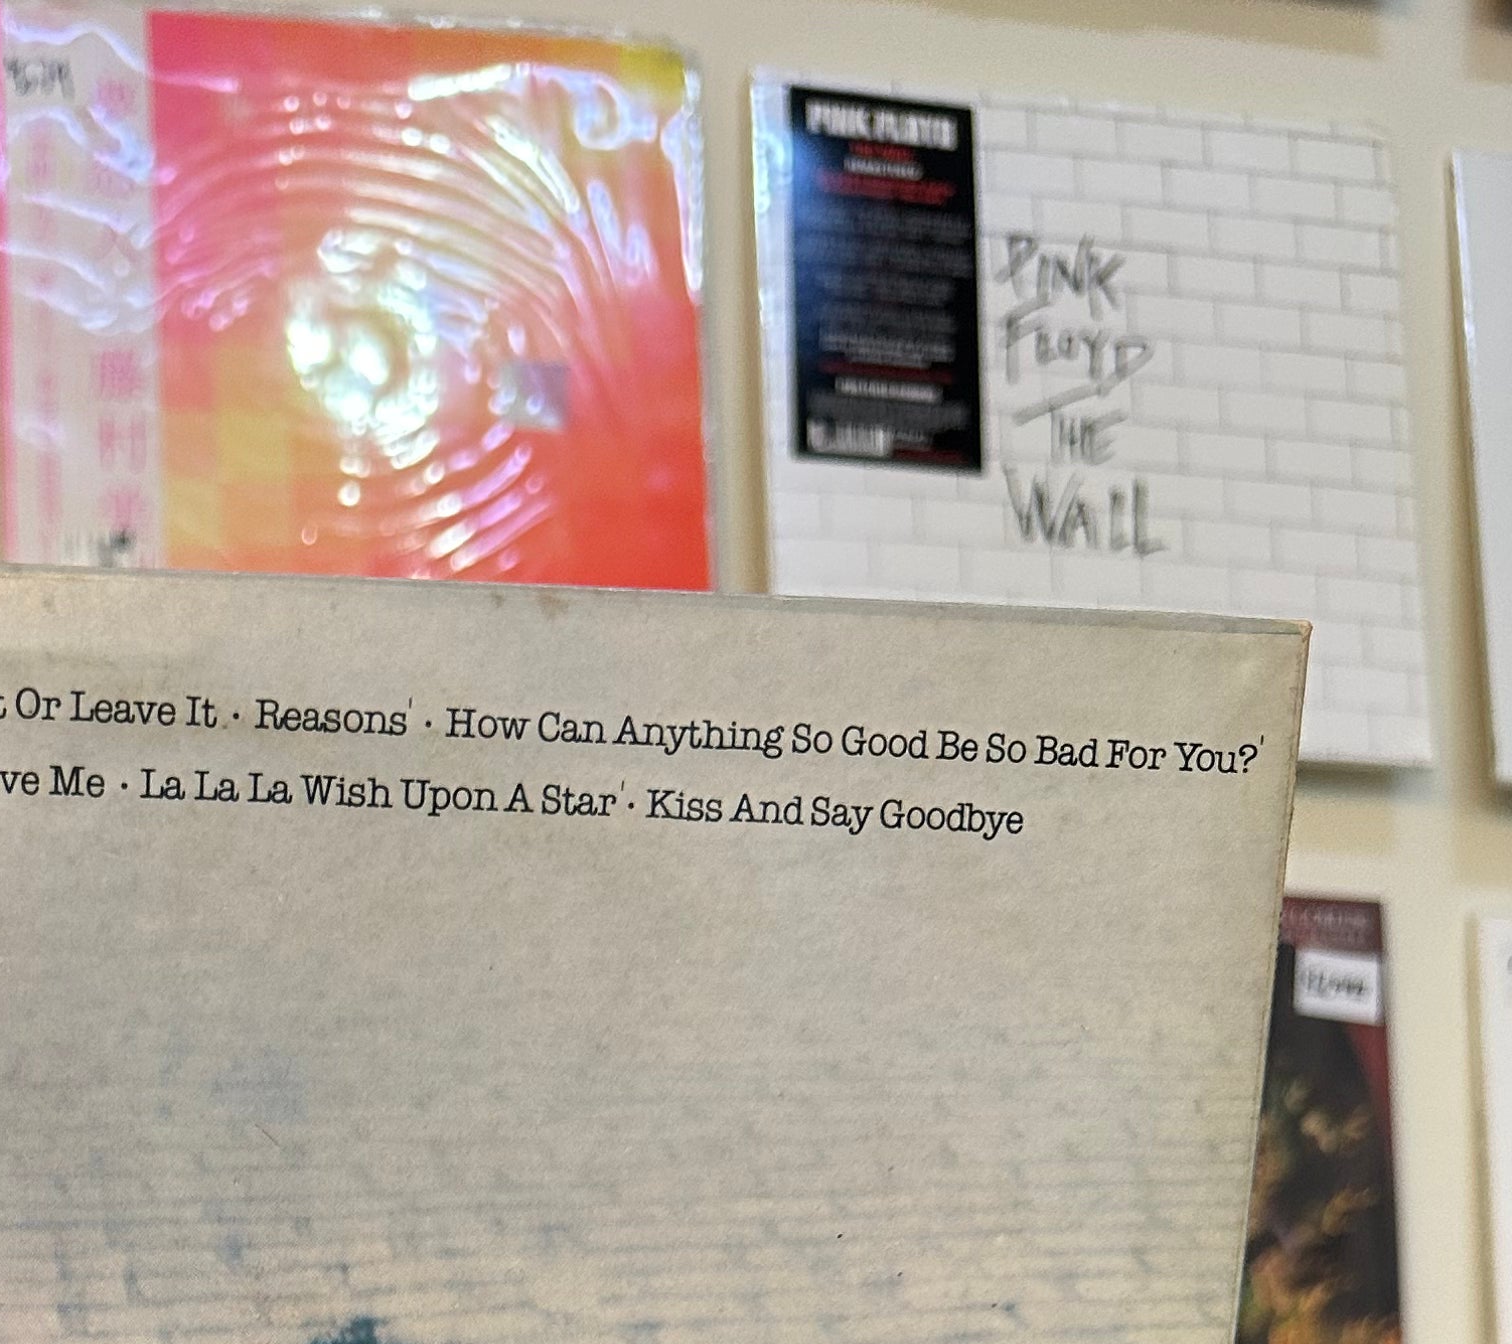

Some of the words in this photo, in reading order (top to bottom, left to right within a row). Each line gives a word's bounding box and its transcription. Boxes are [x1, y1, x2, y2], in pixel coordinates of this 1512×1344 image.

[994, 233, 1126, 320] PINK
[1001, 300, 1154, 395] FLOYD
[1018, 400, 1128, 466] THE
[1001, 463, 1170, 556] WALL
[16, 687, 61, 720] Or
[70, 691, 176, 726] Leave
[186, 696, 217, 728] It
[445, 708, 531, 740] How
[538, 711, 607, 744] Can
[612, 715, 784, 759] Anything
[792, 723, 833, 754] So
[842, 725, 929, 759] Good
[935, 730, 978, 762] Be
[986, 733, 1026, 763] So
[1034, 735, 1099, 767] Bad
[1105, 739, 1166, 770] For
[49, 765, 105, 798] Me
[140, 768, 185, 800] La
[194, 770, 239, 802] La
[247, 773, 293, 804] La
[300, 775, 393, 808] Wish
[400, 779, 499, 817] Upon
[503, 783, 534, 813] A
[645, 789, 722, 822] Kiss
[729, 793, 804, 825] And
[811, 796, 874, 835] Say
[880, 799, 1023, 841] Goodbye
